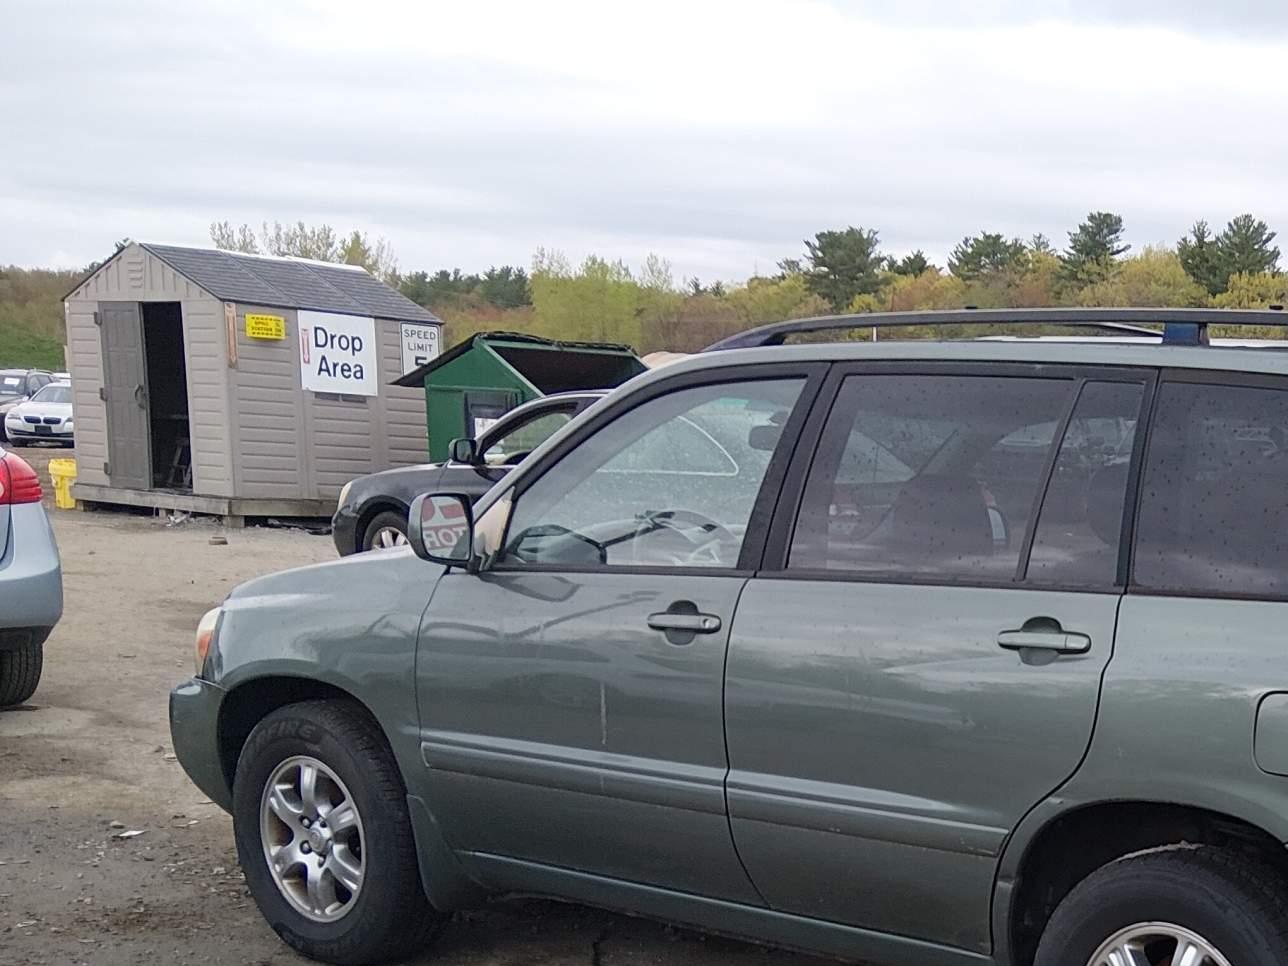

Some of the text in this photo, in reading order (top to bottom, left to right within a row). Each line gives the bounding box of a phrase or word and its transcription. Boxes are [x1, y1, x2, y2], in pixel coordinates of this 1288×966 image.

[314, 326, 363, 357] Drop
[404, 329, 436, 341] SPEED
[408, 342, 433, 352] LIMIT
[317, 355, 364, 380] Area
